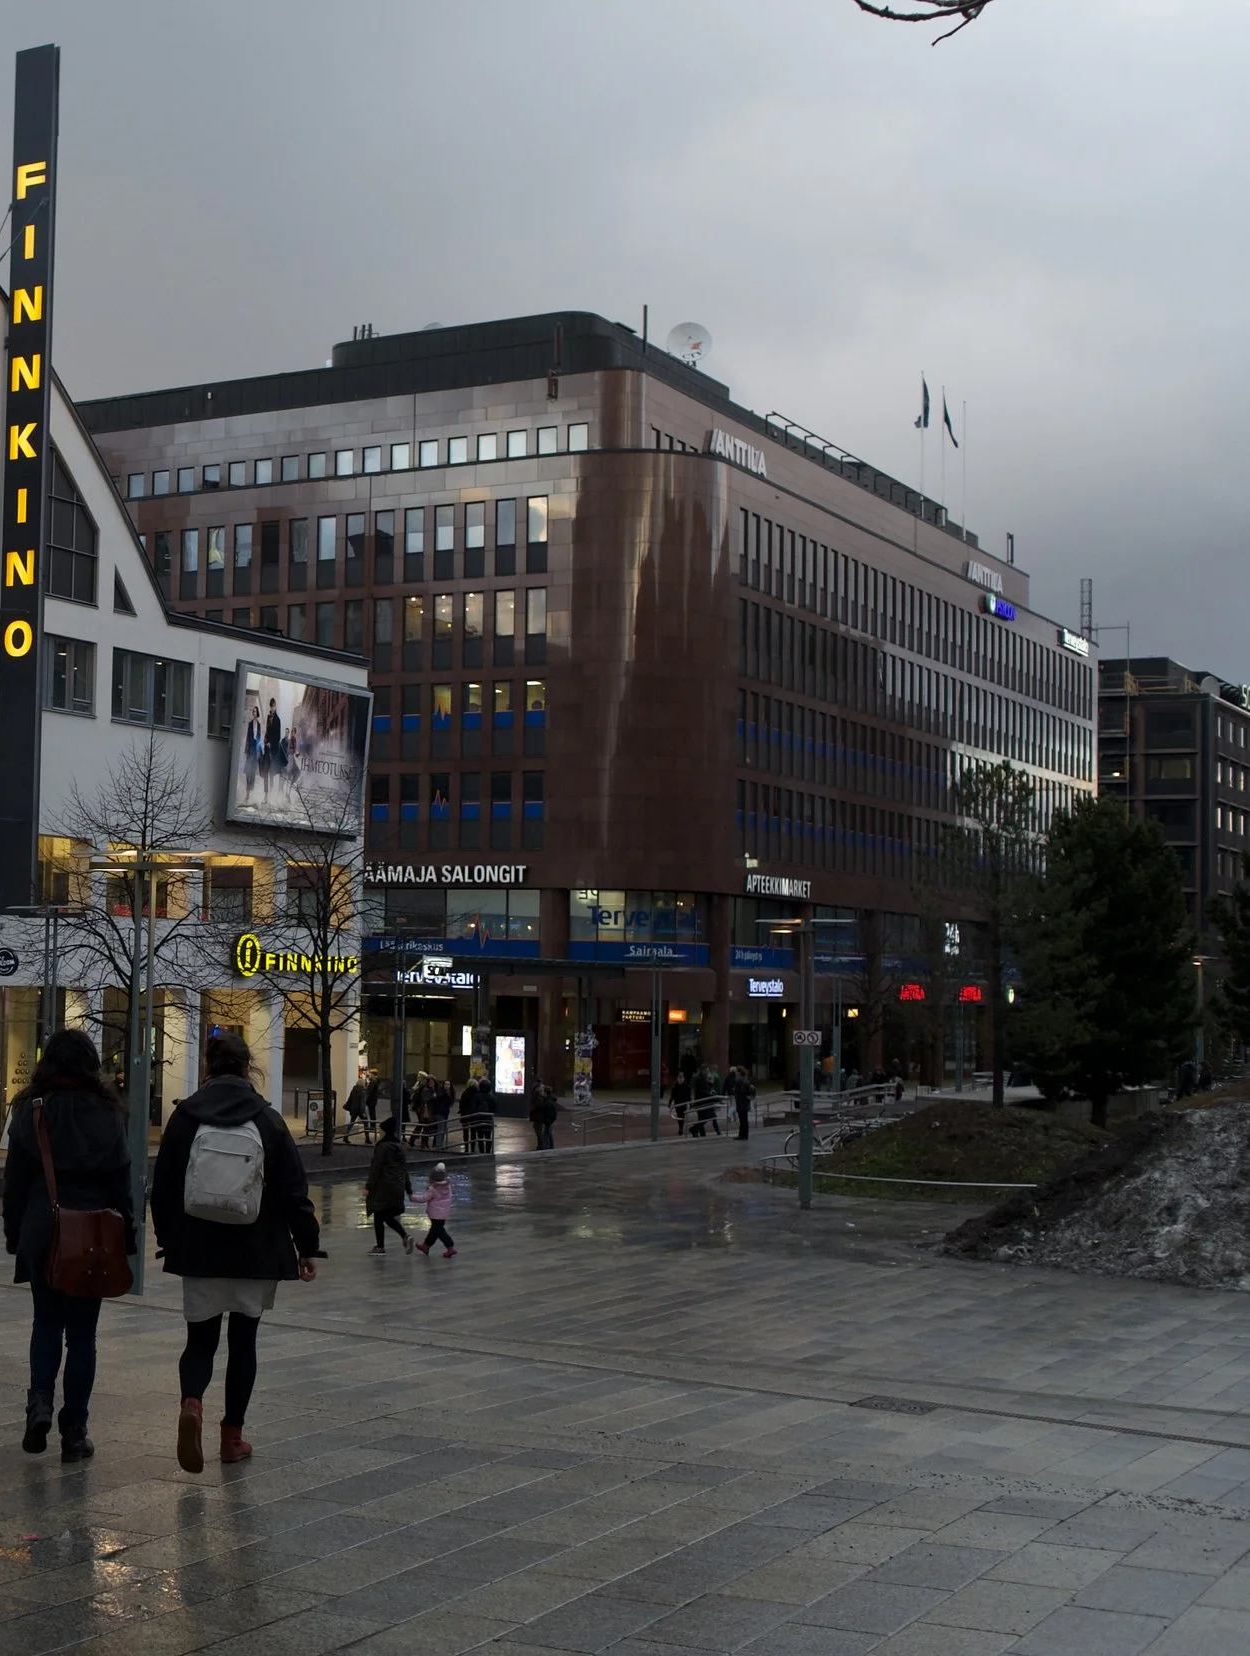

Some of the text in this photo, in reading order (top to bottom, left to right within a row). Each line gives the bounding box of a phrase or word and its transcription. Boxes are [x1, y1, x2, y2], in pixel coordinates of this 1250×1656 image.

[3, 160, 47, 659] FINNKINO
[712, 428, 767, 478] ANTTILA
[441, 864, 528, 883] SALONGIT
